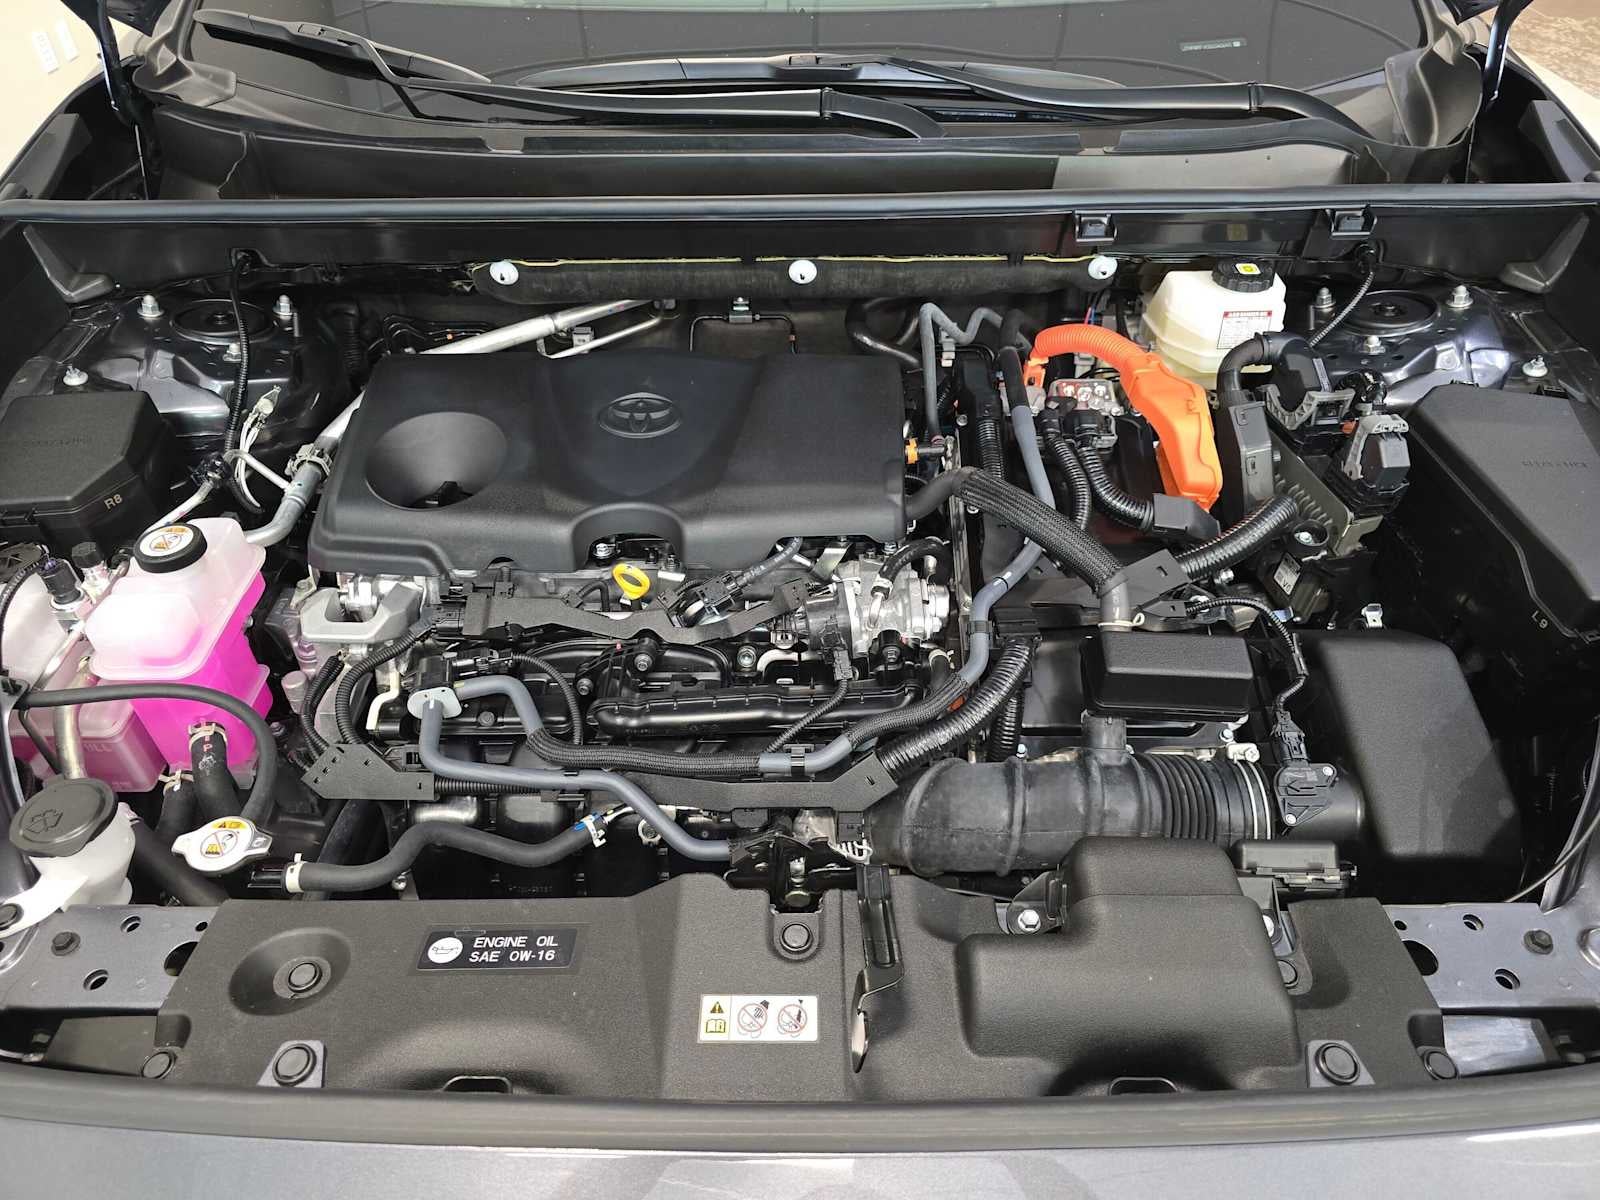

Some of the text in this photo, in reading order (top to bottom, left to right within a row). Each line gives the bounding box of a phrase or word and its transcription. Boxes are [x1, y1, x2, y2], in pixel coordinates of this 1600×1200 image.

[104, 494, 122, 510] R8
[1531, 610, 1548, 629] L9
[473, 935, 559, 948] ENGINE OIL
[469, 949, 556, 963] SAE 0W-16
